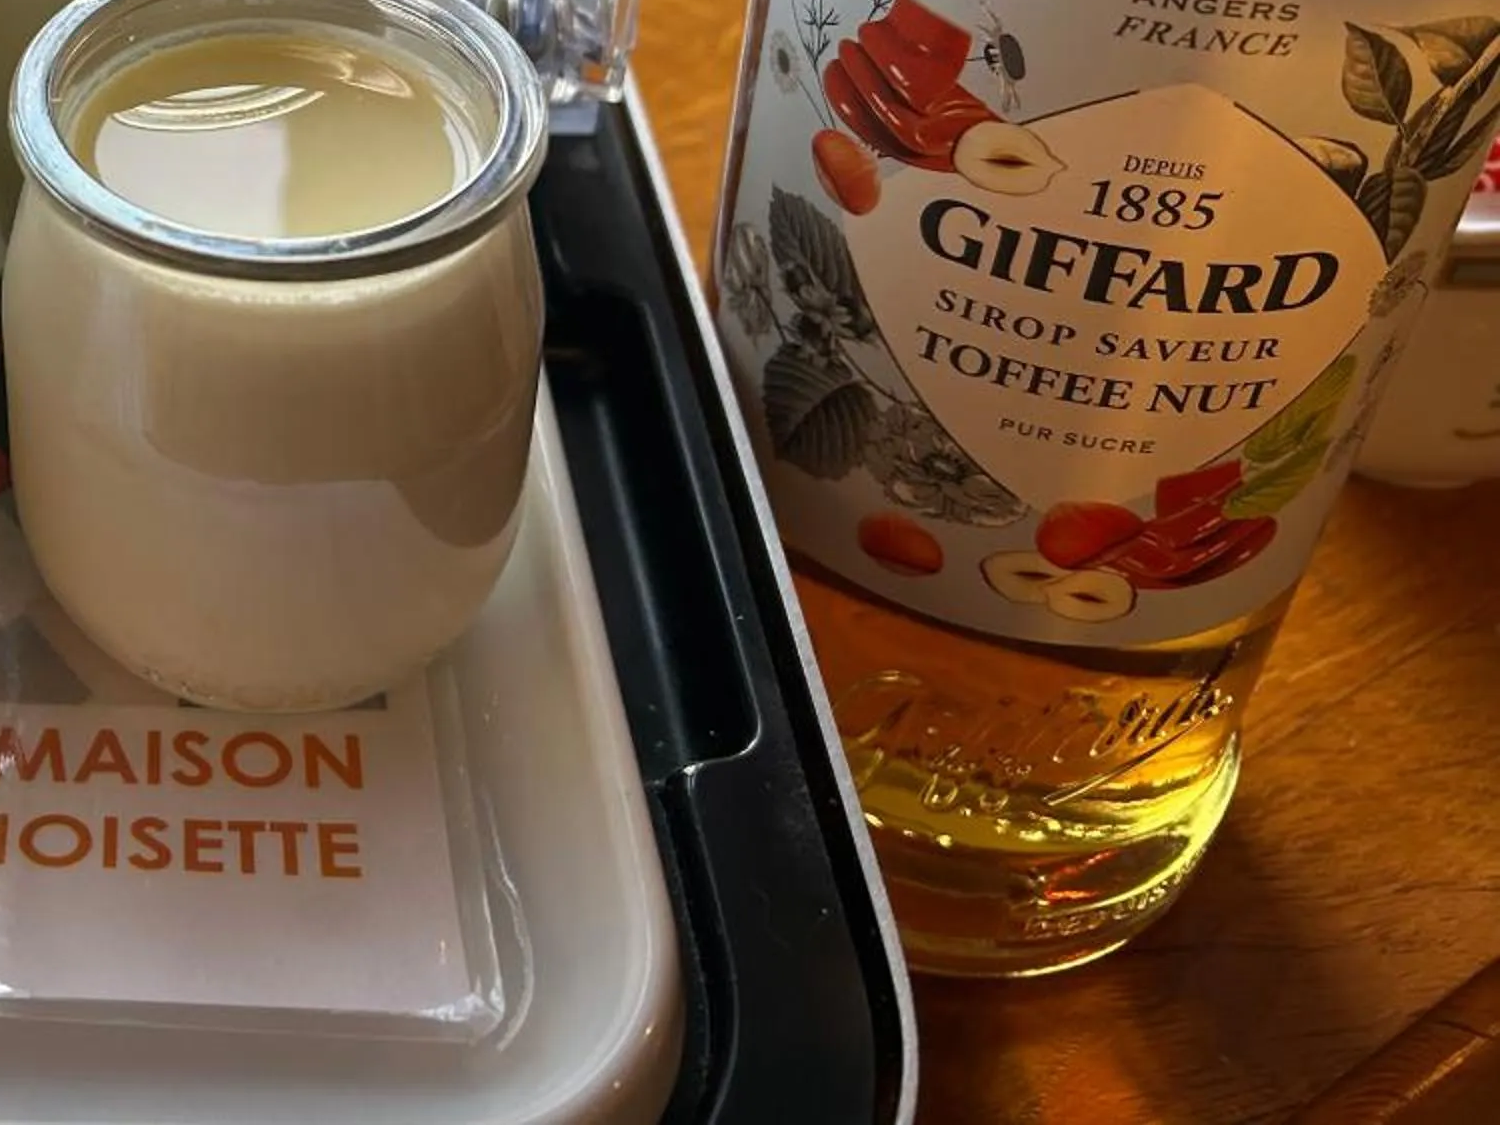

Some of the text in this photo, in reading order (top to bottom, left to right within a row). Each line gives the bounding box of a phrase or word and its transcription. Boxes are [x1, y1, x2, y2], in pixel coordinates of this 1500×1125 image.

[1113, 14, 1299, 58] FRANCE
[1122, 154, 1206, 181] DEPUIS
[1083, 178, 1225, 230] 1885
[919, 198, 1340, 315] GIFFARD
[935, 288, 1281, 364] SIROP SAVEUR
[915, 325, 1279, 415] TOFFEE NUT
[998, 418, 1157, 454] PUR SUCRE
